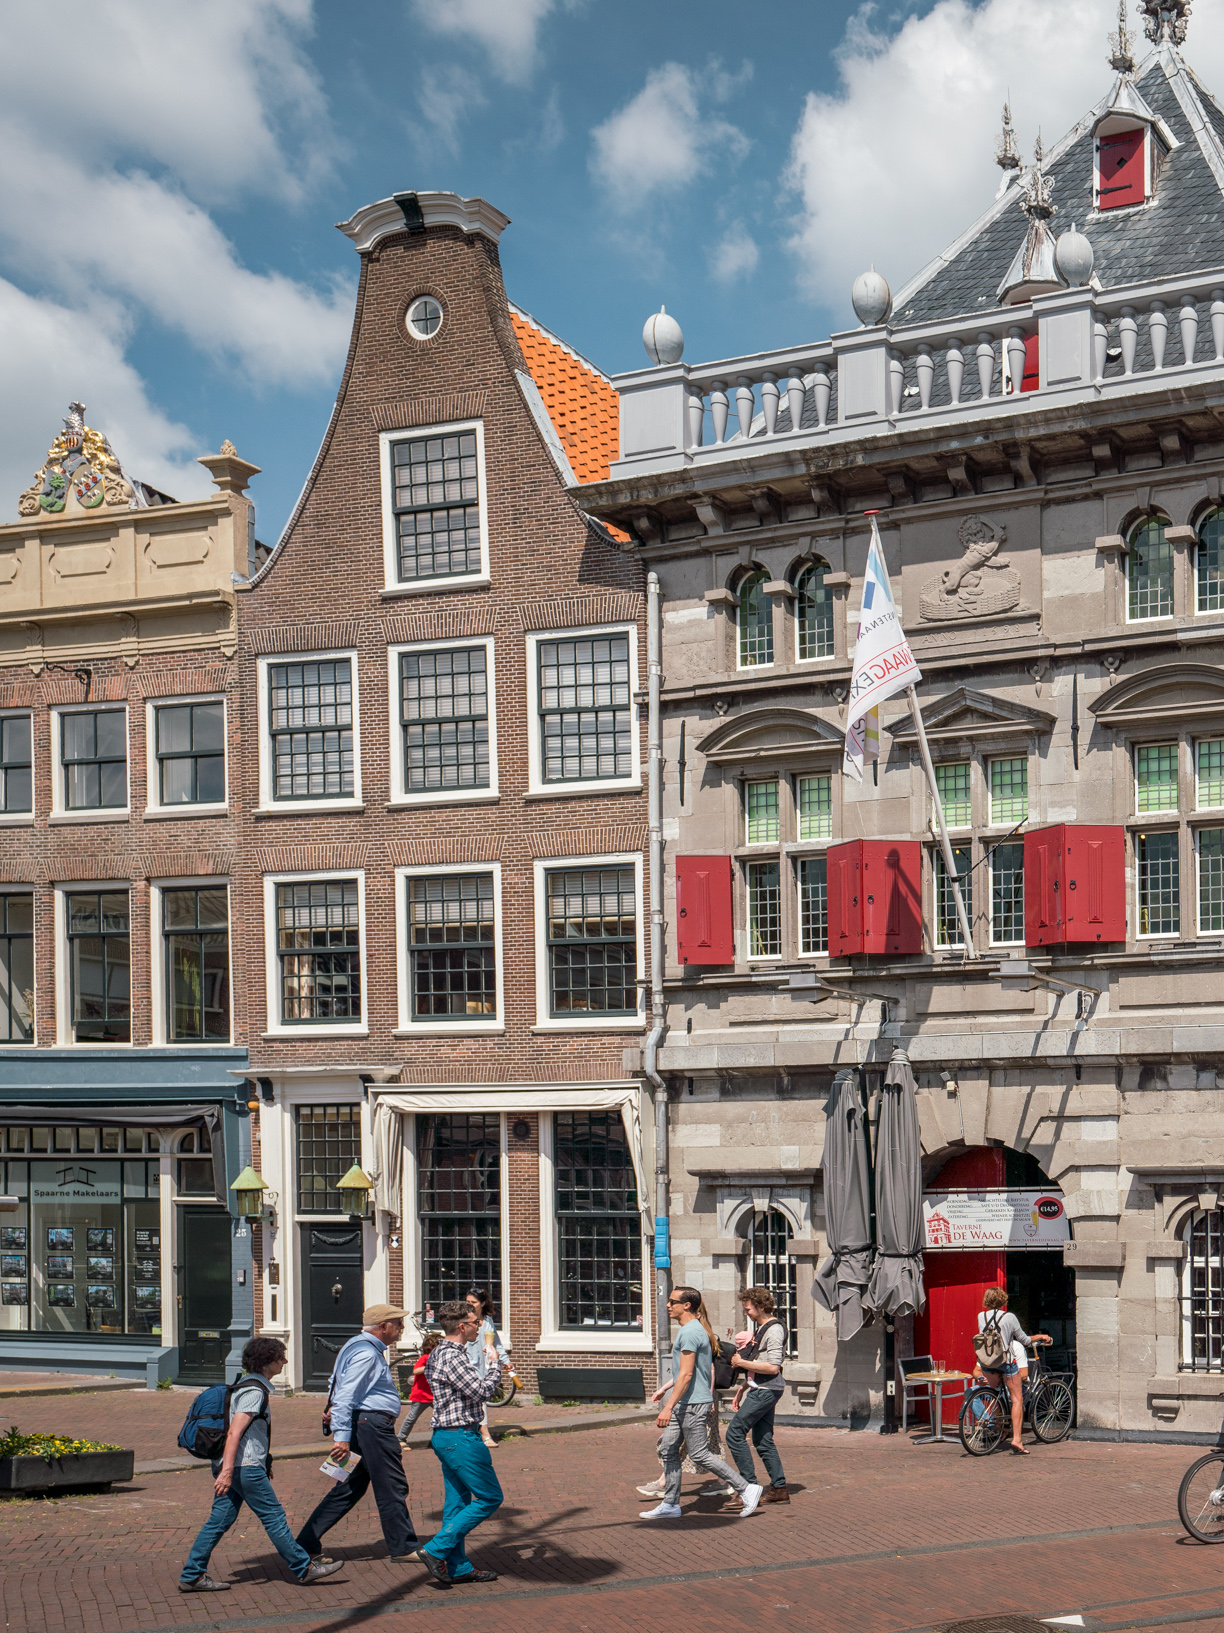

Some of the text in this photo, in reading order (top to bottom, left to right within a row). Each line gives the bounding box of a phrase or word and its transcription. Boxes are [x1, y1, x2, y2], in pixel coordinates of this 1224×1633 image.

[34, 1189, 119, 1198] Spaarne Makelaars
[235, 1228, 247, 1238] 25
[953, 1230, 1003, 1241] DE WAAG
[1066, 1243, 1077, 1251] 29
